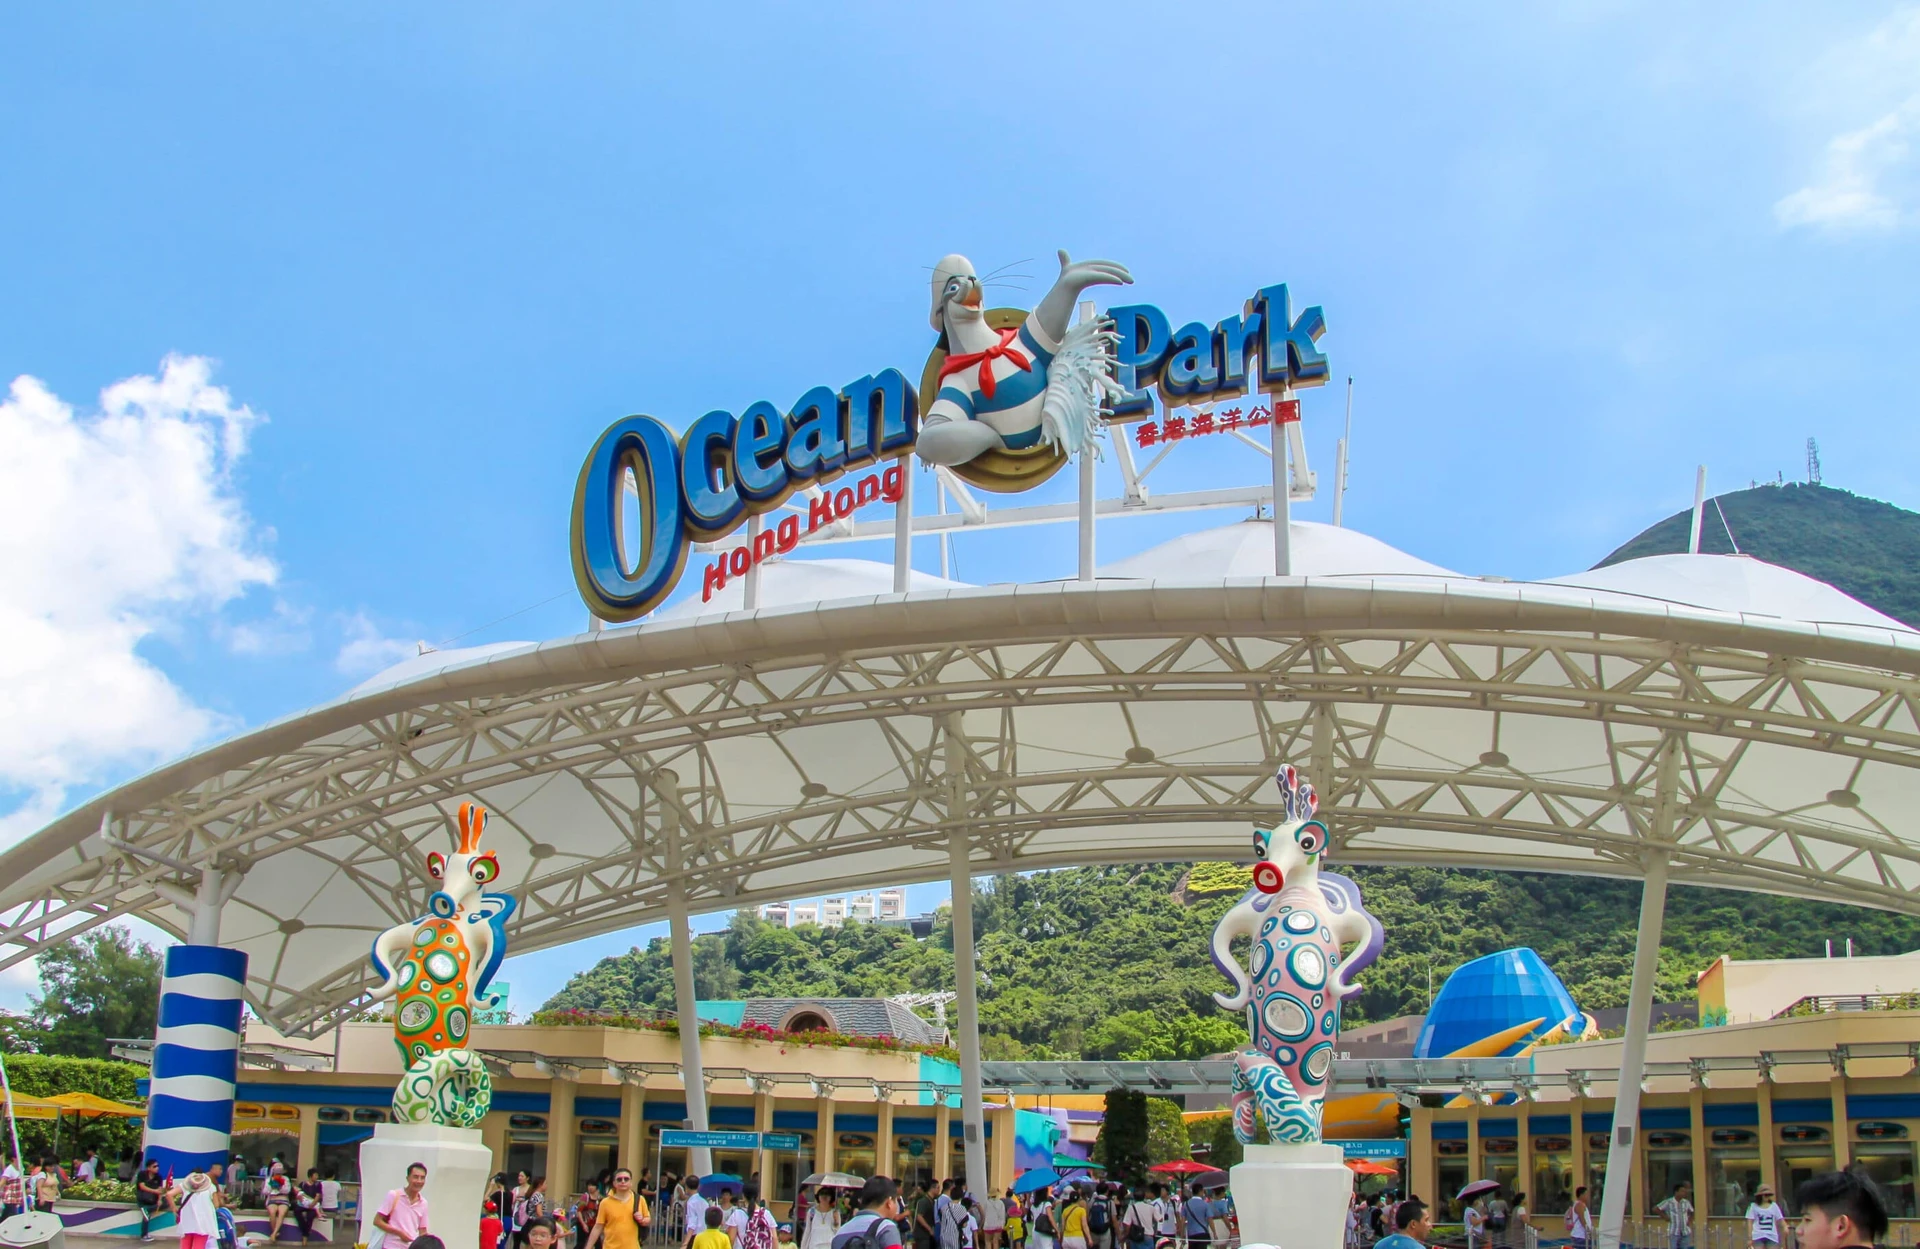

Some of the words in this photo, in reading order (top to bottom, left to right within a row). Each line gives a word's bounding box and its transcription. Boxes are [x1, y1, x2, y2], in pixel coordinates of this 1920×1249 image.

[571, 368, 918, 622] Ocean
[1101, 283, 1330, 427] Park
[1136, 400, 1300, 448] 香港海洋公園
[702, 514, 799, 603] Hong
[809, 465, 904, 533] Kong
[231, 1128, 258, 1136] martFun
